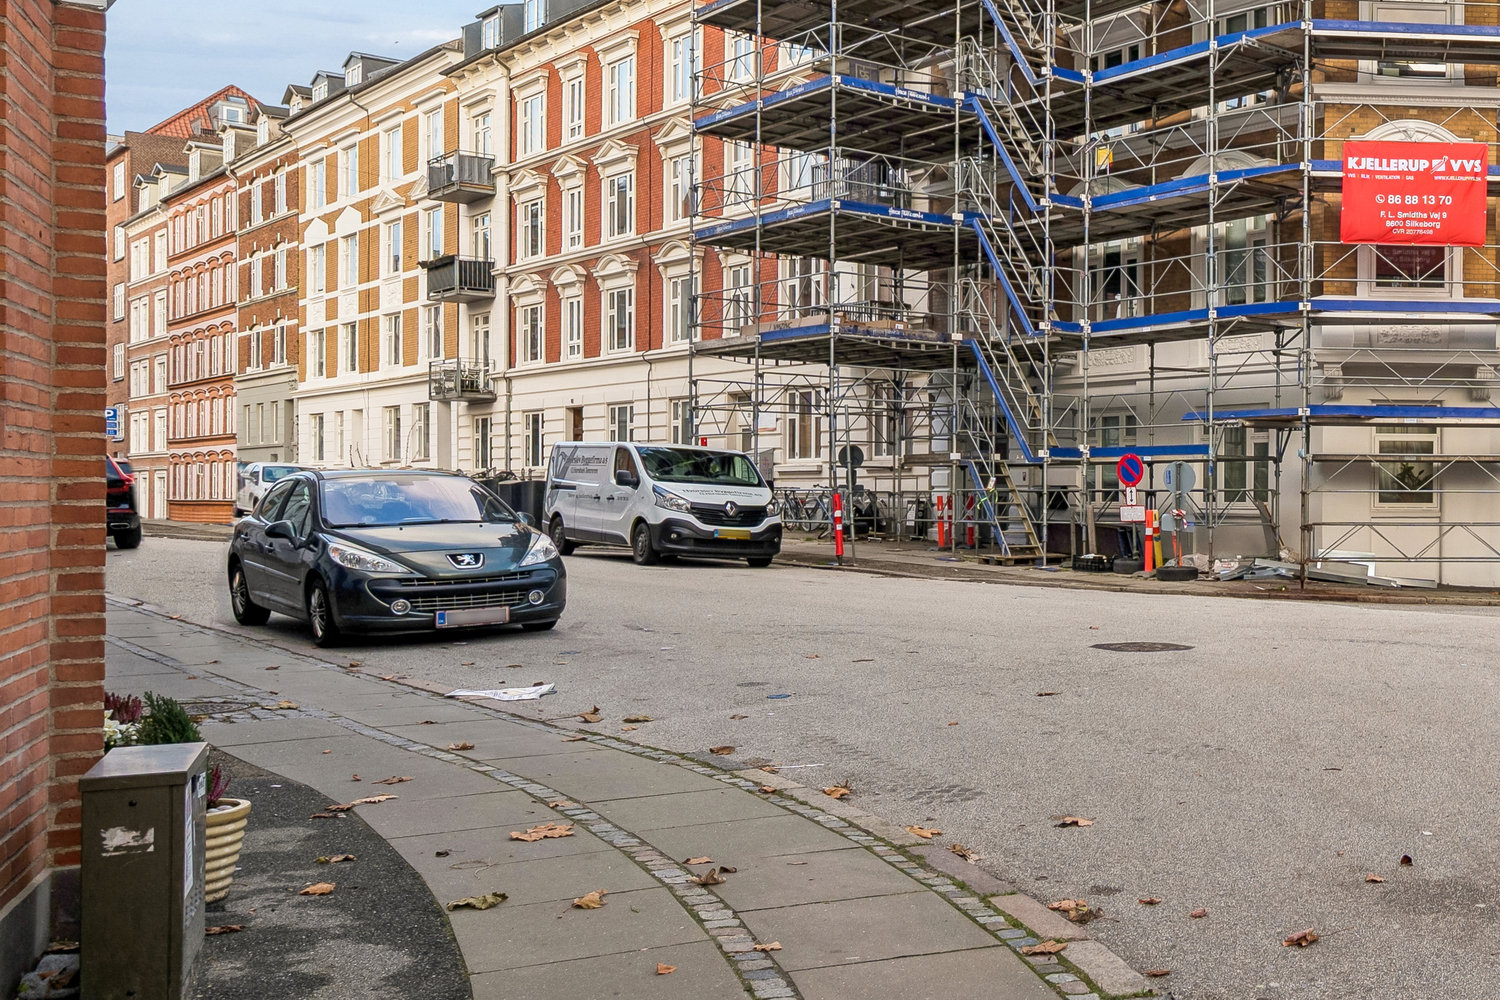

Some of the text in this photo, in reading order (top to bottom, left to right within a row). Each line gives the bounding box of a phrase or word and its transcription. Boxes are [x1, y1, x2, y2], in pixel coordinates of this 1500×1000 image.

[1347, 157, 1481, 172] KJELLERUP VVS
[1388, 195, 1452, 205] 86 88 13 70
[1430, 212, 1440, 220] Vej
[1405, 220, 1440, 229] Silkeborg
